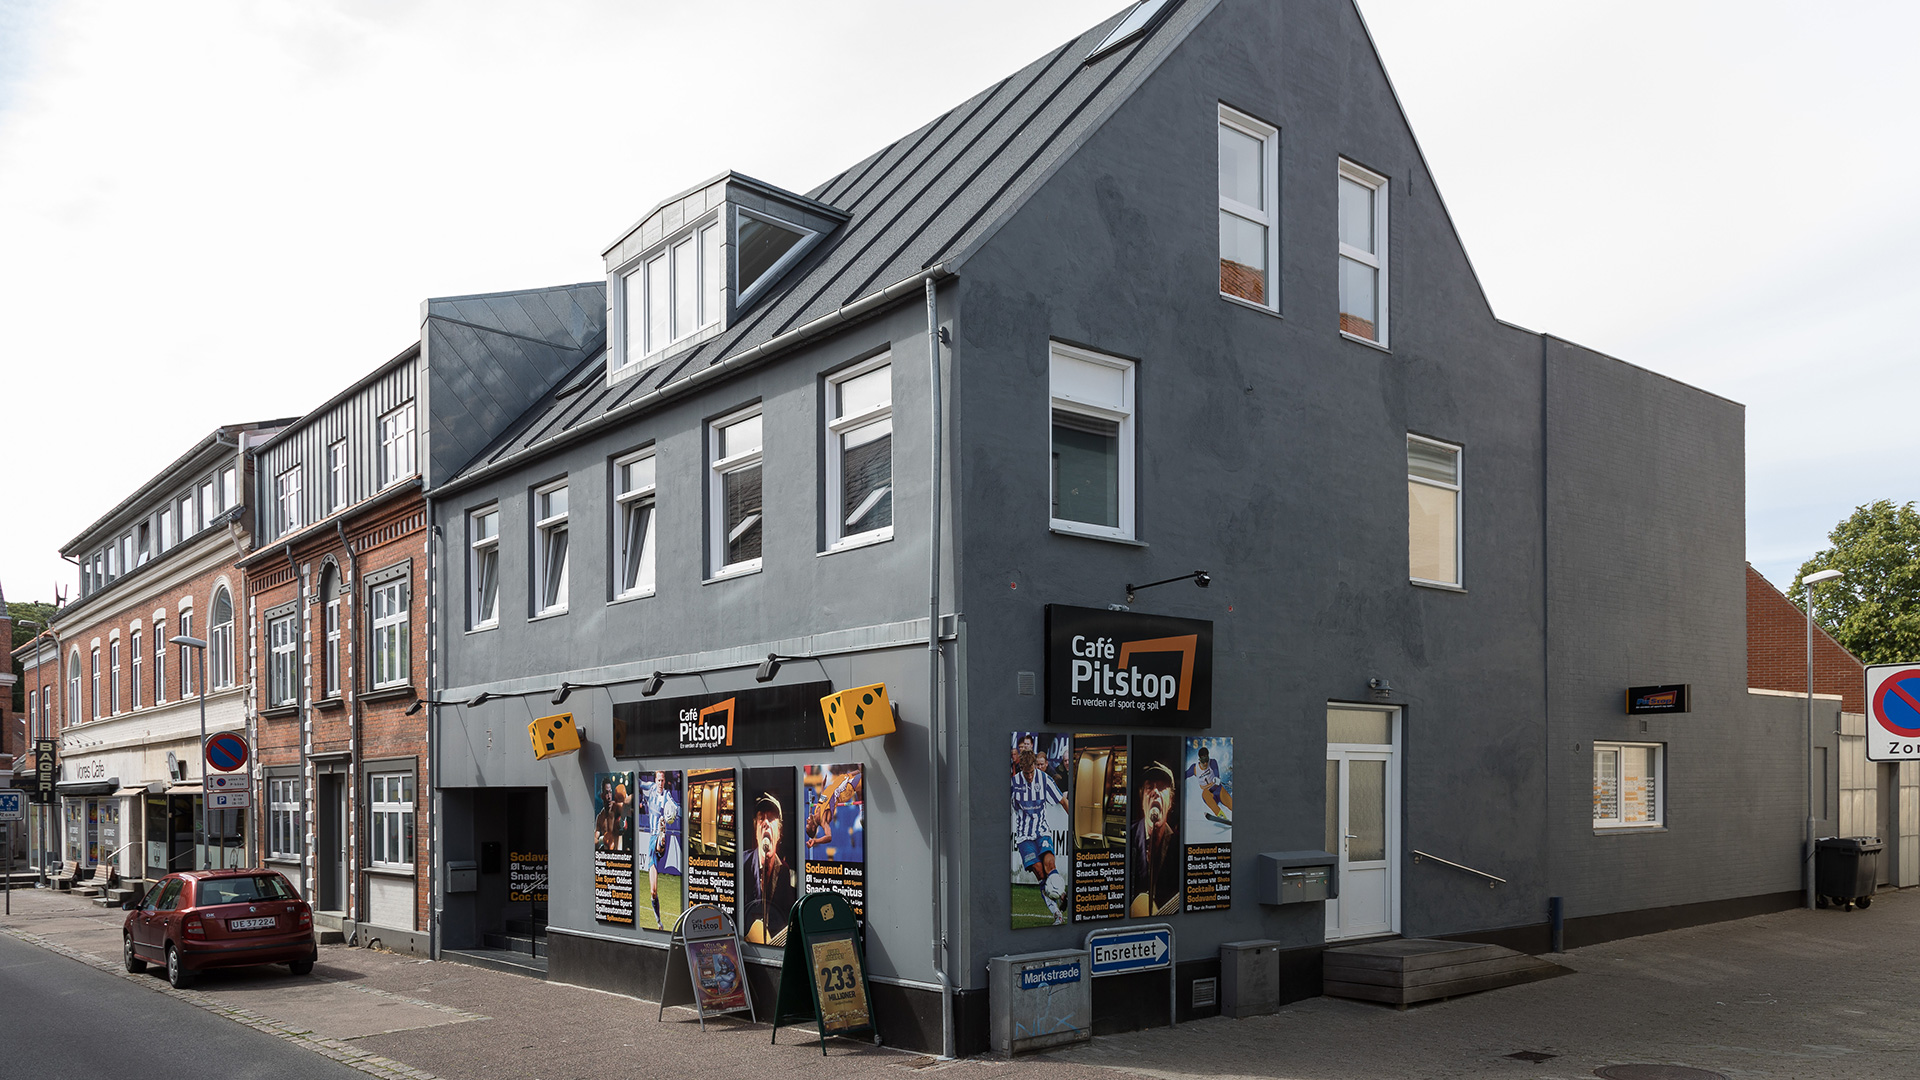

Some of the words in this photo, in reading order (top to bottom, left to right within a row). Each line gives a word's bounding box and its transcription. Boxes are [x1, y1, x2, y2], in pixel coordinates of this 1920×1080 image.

[1072, 635, 1115, 659] Café
[1072, 659, 1176, 706] Pitstop
[1072, 696, 1081, 706] En
[1083, 698, 1107, 707] verden
[1109, 699, 1116, 707] af
[1118, 700, 1135, 710] sport
[1136, 701, 1146, 711] og
[1147, 701, 1159, 711] spil
[680, 708, 698, 721] Café
[680, 722, 726, 744] Pitstop
[40, 742, 52, 801] BAGERI
[76, 762, 90, 780] Vores
[1076, 851, 1109, 860] Sodavand
[1188, 846, 1217, 855] Sodavand
[595, 851, 632, 861] Spilleautomater
[689, 856, 718, 867] Sodavand
[1208, 861, 1230, 870] Spiritus
[595, 867, 632, 877] Spilleautomater
[805, 862, 842, 875] Sodavand
[844, 868, 862, 876] Drinks
[1076, 869, 1099, 877] Snacks
[1100, 867, 1124, 877] Spiritus
[511, 872, 547, 880] Snacks
[603, 876, 616, 884] Sport
[806, 874, 812, 883] Øl
[689, 875, 708, 885] Snacks
[710, 876, 734, 888] Spiritus
[595, 889, 611, 897] Oddset
[612, 890, 632, 899] Dantoto
[1187, 885, 1215, 894] Cocktails
[719, 894, 734, 903] Shots
[1076, 892, 1107, 902] Cocktails
[1187, 893, 1216, 903] Sodavand
[620, 900, 632, 908] Sport
[1076, 902, 1109, 912] Sodavand
[595, 904, 632, 916] Spilleautomater
[1095, 942, 1157, 962] Ensrettet
[821, 964, 856, 992] 233
[1024, 967, 1079, 984] Markstræde
[828, 991, 856, 1001] MILLIONER
